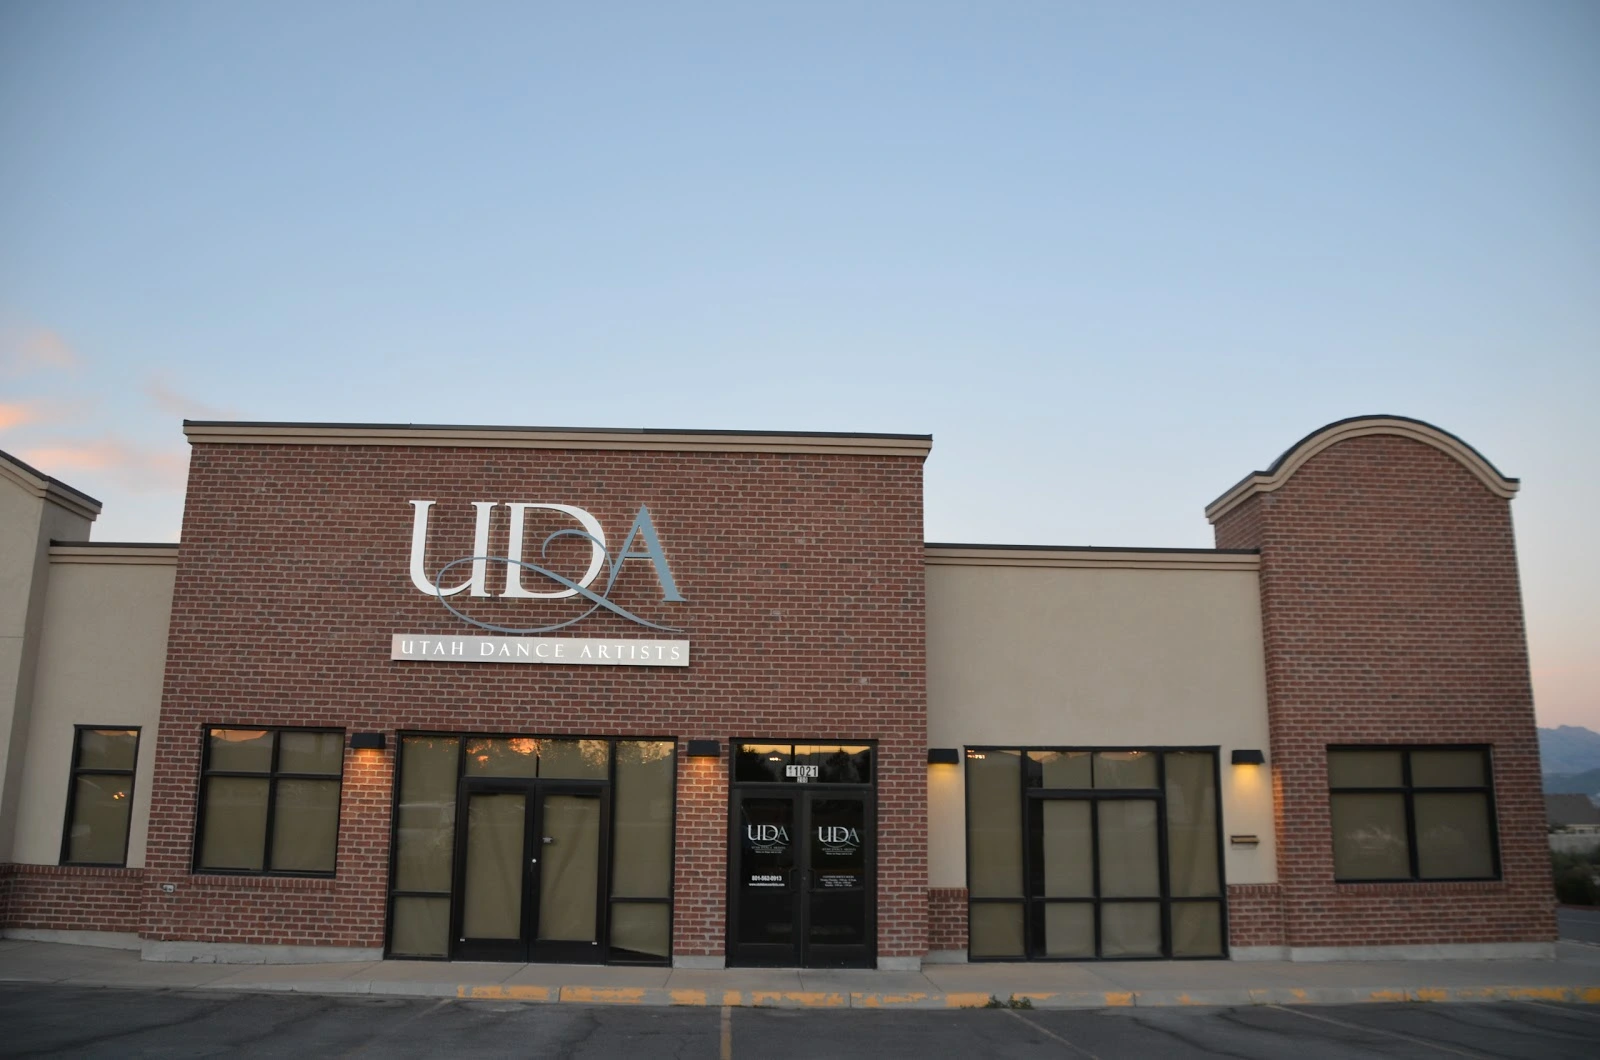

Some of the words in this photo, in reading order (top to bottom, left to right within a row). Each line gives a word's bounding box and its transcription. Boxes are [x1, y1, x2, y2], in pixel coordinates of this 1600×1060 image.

[409, 500, 687, 602] UDA
[401, 640, 464, 656] UTAH
[480, 642, 565, 658] DANCE
[580, 644, 680, 661] ARTISTS
[748, 824, 790, 841] UDA
[818, 826, 860, 843] UDA
